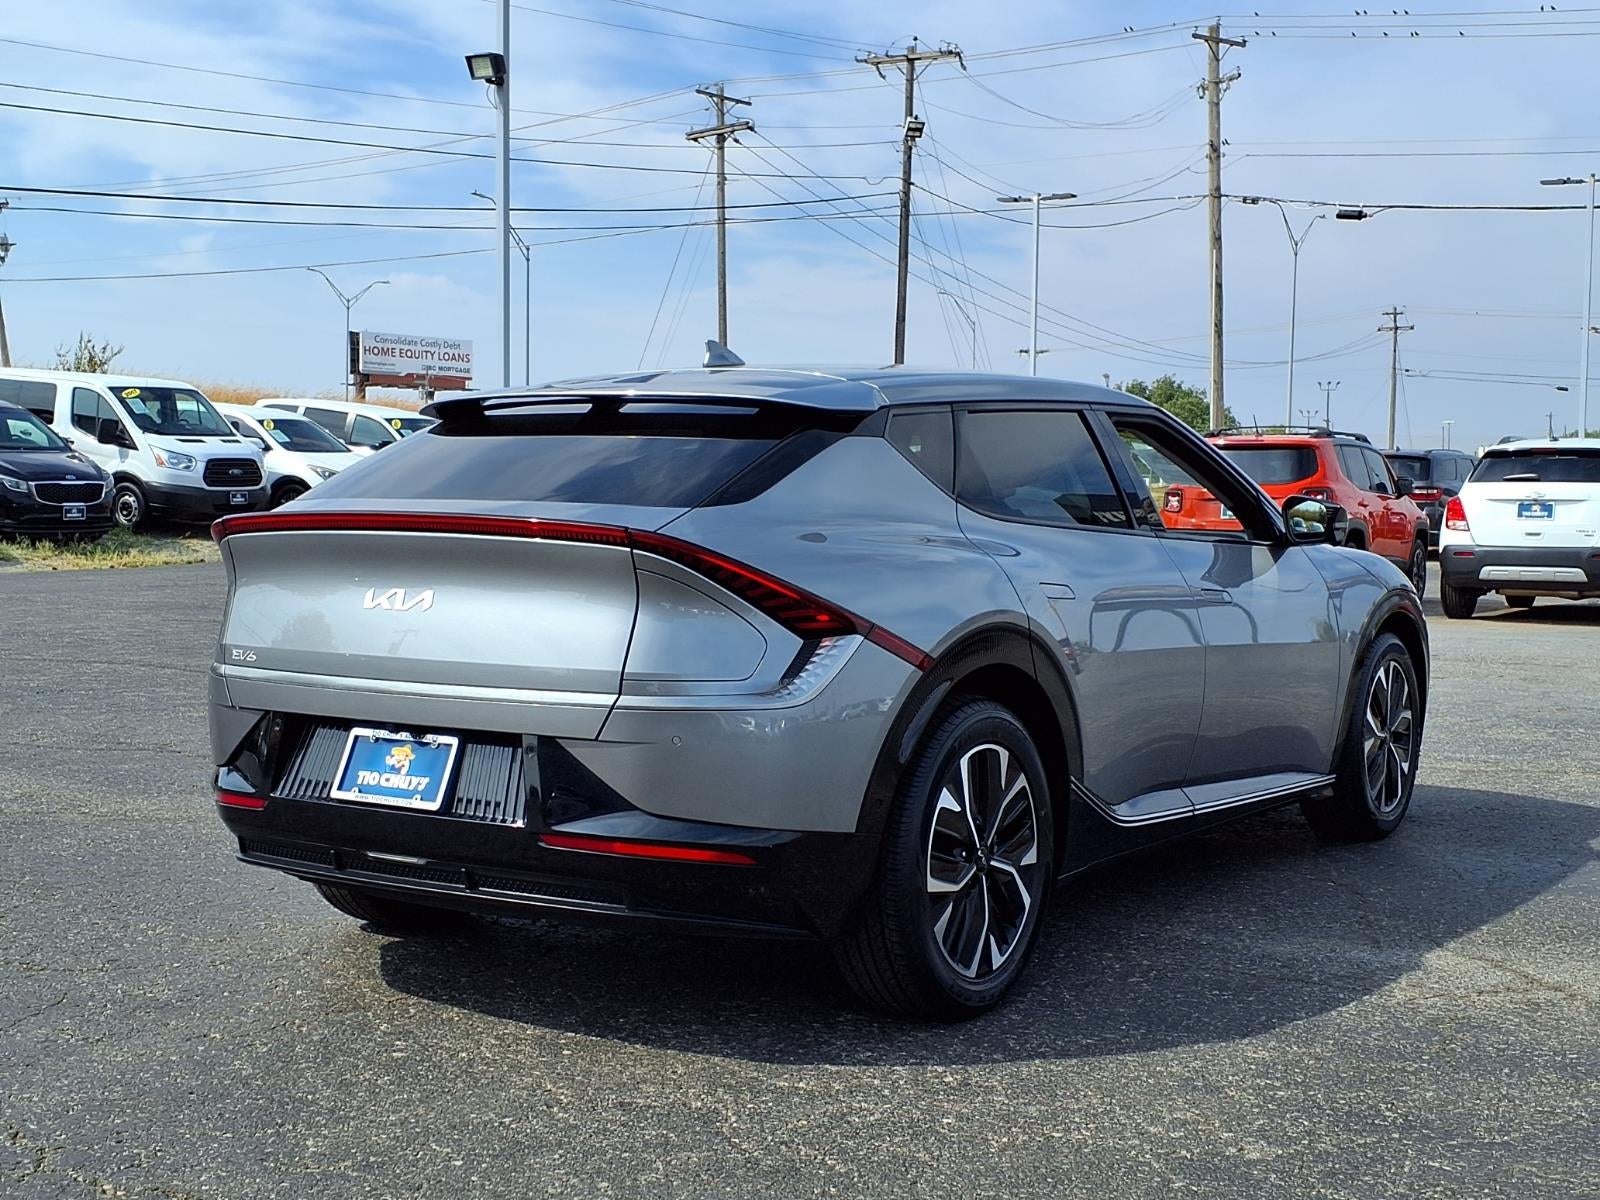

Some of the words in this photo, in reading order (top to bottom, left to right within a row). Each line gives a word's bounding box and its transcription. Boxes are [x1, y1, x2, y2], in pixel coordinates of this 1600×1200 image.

[374, 335, 418, 347] Consolidate
[419, 340, 442, 350] Costly
[443, 341, 461, 350] Debt
[363, 345, 396, 358] HOME
[398, 348, 435, 361] EQUITY
[437, 352, 471, 363] LOANS
[438, 365, 471, 374] MORTGAGE
[363, 587, 435, 612] KIA
[231, 649, 257, 662] EV6
[357, 771, 380, 785] TIO
